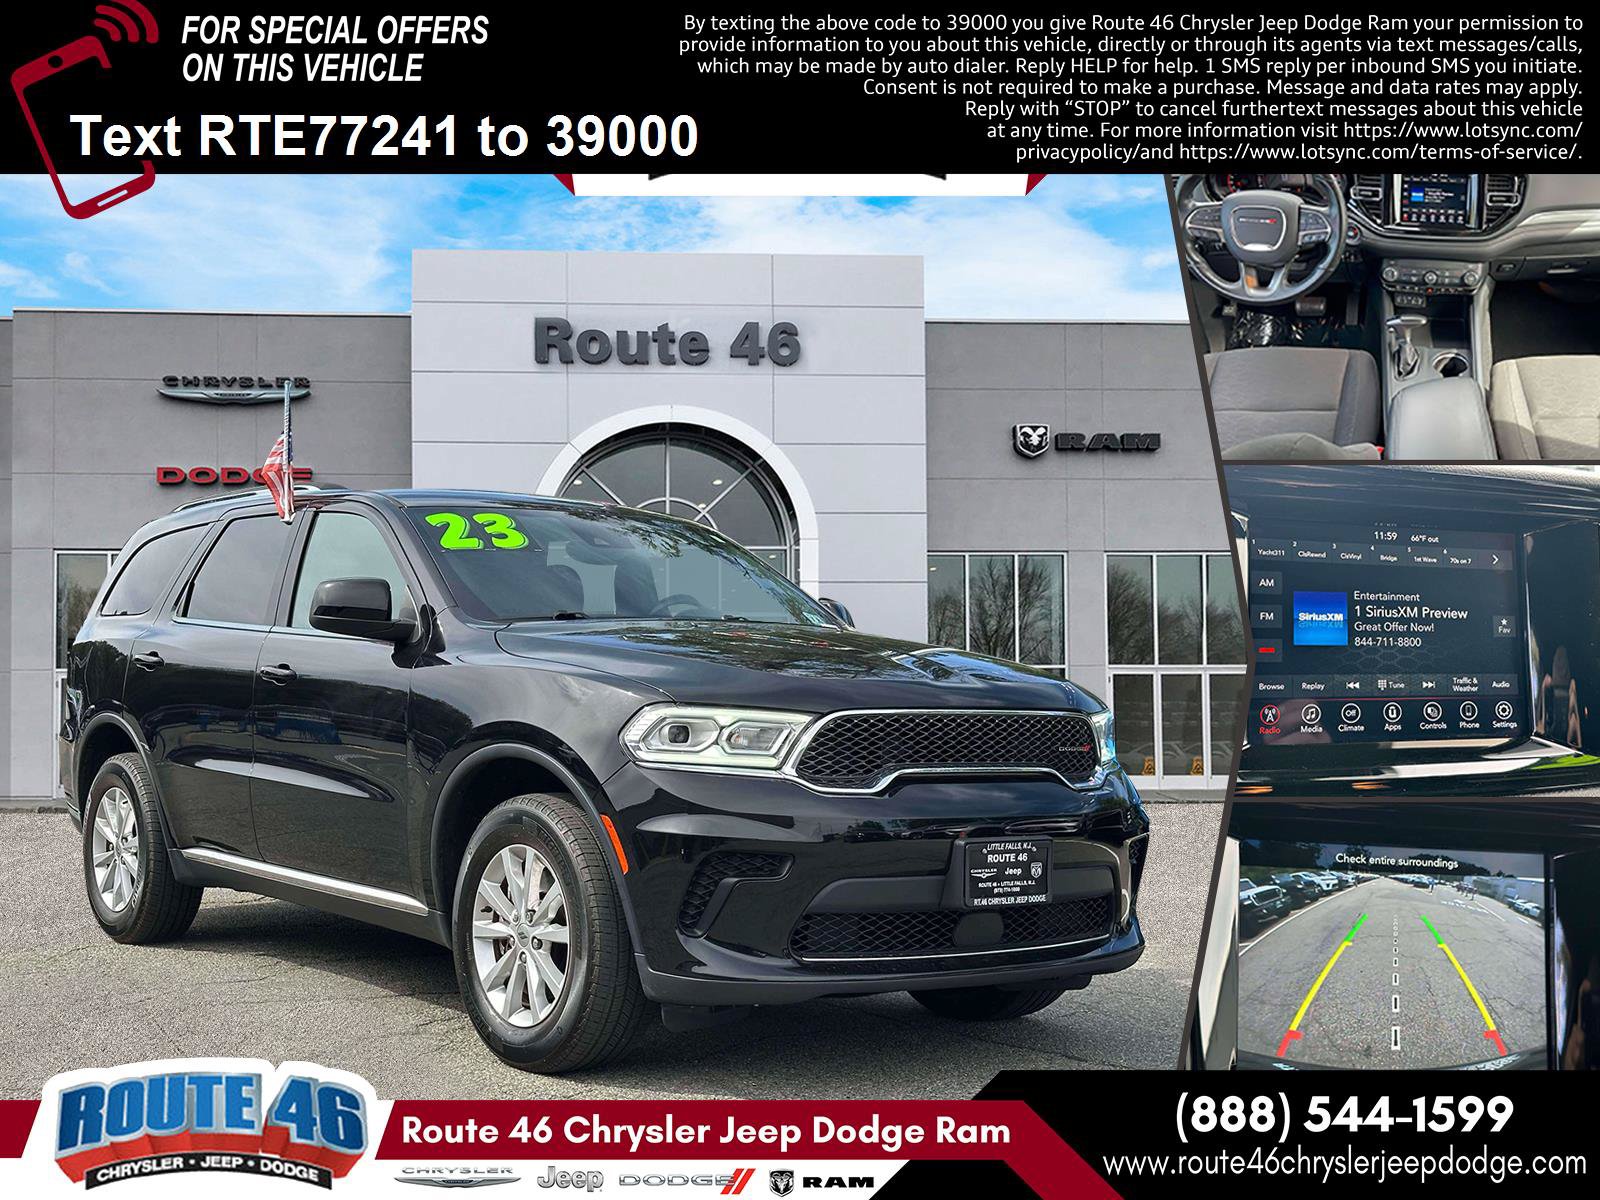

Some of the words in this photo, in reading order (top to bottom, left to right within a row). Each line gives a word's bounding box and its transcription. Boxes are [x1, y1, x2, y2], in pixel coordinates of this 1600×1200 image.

[534, 317, 710, 365] Route
[729, 320, 801, 367] 46
[162, 375, 311, 388] CHRYSLER
[1055, 433, 1161, 451] RAM
[424, 512, 529, 550] 23
[1374, 531, 1398, 540] 11:59
[1259, 578, 1275, 587] AM
[1353, 590, 1420, 602] Entertainment
[1259, 612, 1274, 620] FM
[1298, 612, 1344, 621] SiriusXM
[1354, 605, 1361, 617] 1
[1365, 605, 1418, 618] SiriusXM
[1422, 606, 1469, 619] Preview
[1354, 621, 1382, 632] Great
[1383, 621, 1408, 632] Offer
[1410, 622, 1435, 632] Now!
[1498, 626, 1511, 634] Fav
[1354, 636, 1422, 648] 844-711-8800
[1258, 682, 1285, 690] Browse
[1301, 682, 1325, 691] Replay
[1388, 681, 1405, 689] Tune
[1491, 680, 1510, 688] Audio
[1345, 709, 1357, 717] Off
[1300, 725, 1323, 733] Media
[1338, 724, 1365, 732] Climate
[1384, 722, 1402, 731] Apps
[1420, 722, 1447, 730] Controls
[1459, 721, 1480, 729] Phone
[1492, 720, 1518, 729] Settings
[1259, 726, 1281, 734] Radio
[987, 843, 1004, 851] LITTLE
[987, 853, 1016, 863] ROUTE
[1017, 853, 1028, 862] 46
[1335, 852, 1367, 864] Check
[1369, 855, 1396, 866] entire
[1398, 857, 1459, 870] surroundings
[1004, 867, 1022, 876] Jeep
[987, 896, 1015, 905] CHRYSLER
[1015, 895, 1028, 904] JEEP
[1028, 894, 1047, 903] DODGE
